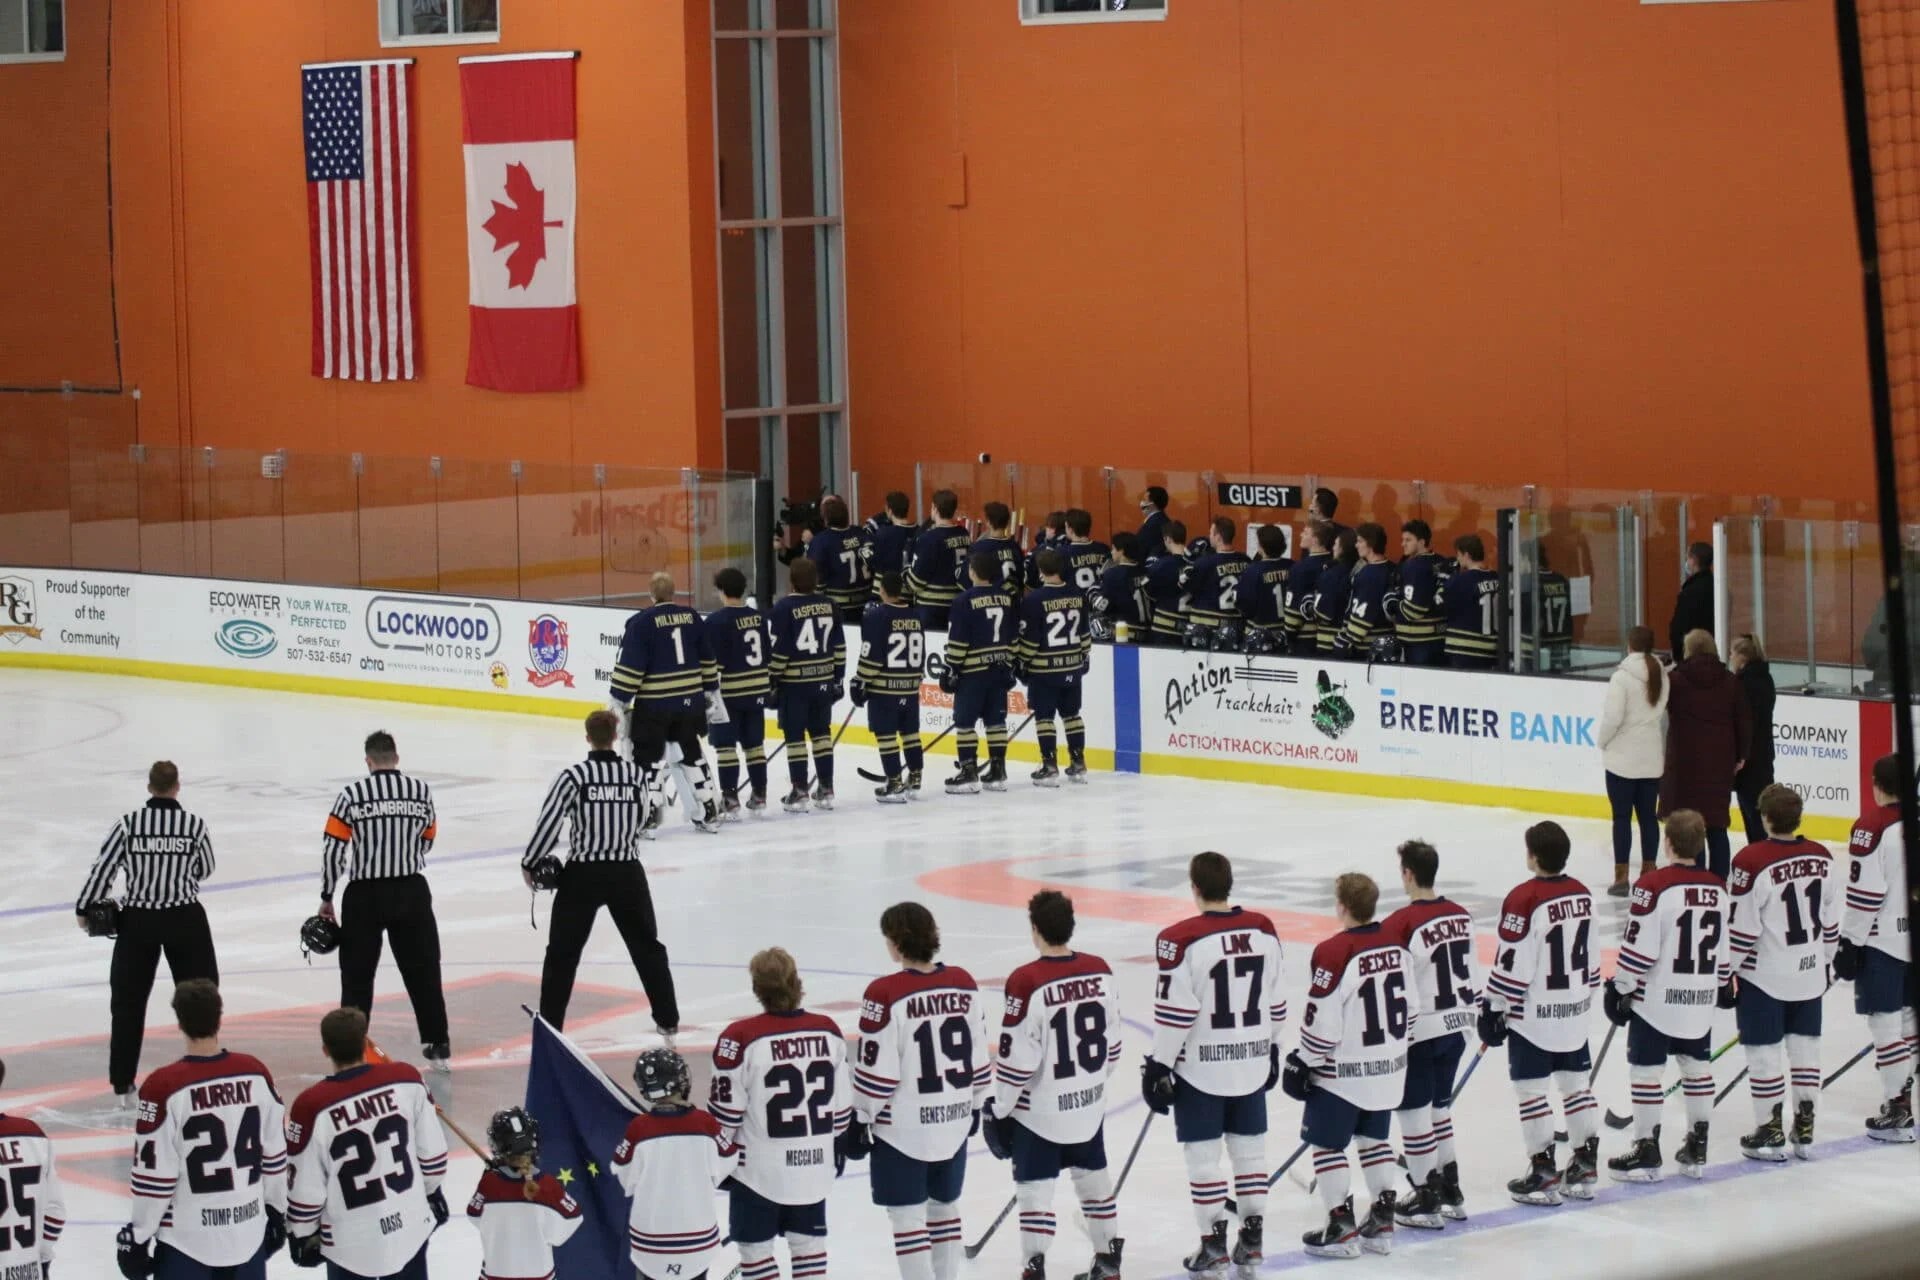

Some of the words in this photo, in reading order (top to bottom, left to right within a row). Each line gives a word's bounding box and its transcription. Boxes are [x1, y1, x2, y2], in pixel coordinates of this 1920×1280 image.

[1229, 485, 1290, 507] GUEST
[839, 551, 858, 584] 7
[46, 579, 79, 595] Proud
[81, 581, 130, 598] Supporter
[210, 591, 281, 611] ECOWATER
[75, 605, 86, 619] of
[88, 605, 105, 620] the
[1042, 597, 1083, 612] THOMPSON
[1544, 597, 1567, 632] 17
[60, 630, 120, 649] Community
[377, 611, 489, 642] LOCKWOOD
[796, 617, 834, 654] 47
[986, 607, 1004, 643] 7
[1046, 609, 1080, 648] 22
[287, 649, 352, 664] 507-532-6547
[425, 643, 482, 660] MOTORS
[671, 627, 685, 665] 1
[743, 629, 763, 667] 3
[887, 632, 923, 668] 28
[1165, 662, 1233, 726] Action
[1213, 688, 1294, 716] Trackchair
[926, 711, 942, 726] Get
[1380, 701, 1500, 738] BREMER
[1510, 711, 1596, 748] BANK
[1772, 723, 1848, 744] COMPANY
[1168, 732, 1359, 764] ACTIONTRACKCHAIR.COM
[1775, 743, 1808, 758] TOWN
[1812, 746, 1848, 760] TEAMS
[588, 786, 634, 801] GAWLIK
[350, 800, 428, 820] McCAMBRIDGE
[132, 837, 193, 854] ALMQUIST
[1769, 859, 1828, 885] HERZBERG
[1547, 897, 1592, 924] BUTLER
[1781, 878, 1822, 946] 11
[1221, 934, 1253, 955] LINK
[1545, 918, 1591, 990] 14
[1672, 909, 1722, 974] 12
[1430, 939, 1475, 1010] 15
[1209, 955, 1264, 1029] 17
[1358, 971, 1408, 1047] 16
[770, 1036, 830, 1061] RICOTTA
[913, 1015, 975, 1094] 19
[1050, 1001, 1107, 1080] 18
[1199, 1042, 1248, 1062] BULLETPROOF
[190, 1080, 253, 1111] MURRAY
[329, 1089, 399, 1131] PLANTE
[764, 1060, 835, 1138] 22
[182, 1105, 263, 1194] 24
[329, 1113, 414, 1210] 23
[785, 1150, 812, 1166] MECCA
[201, 1208, 231, 1226] STUMP
[380, 1212, 403, 1235] OASIS
